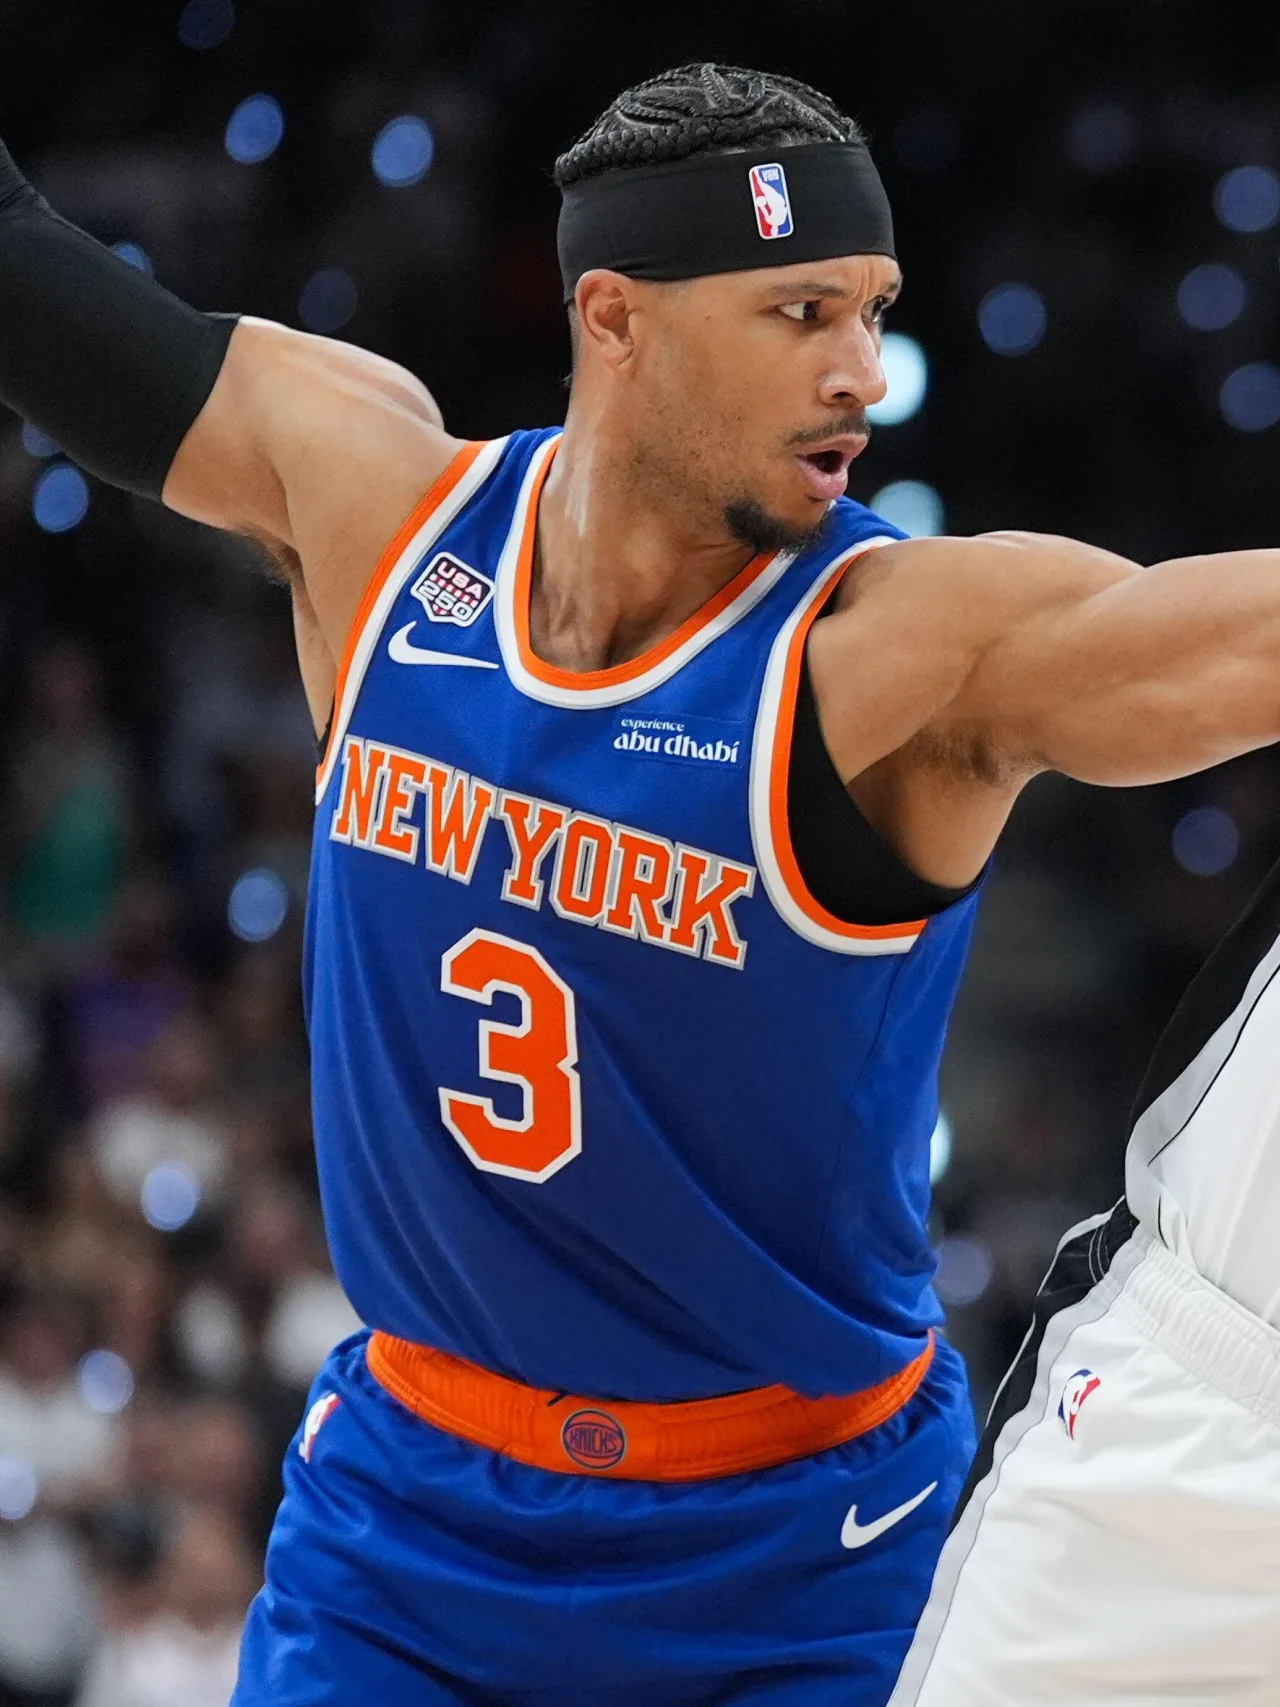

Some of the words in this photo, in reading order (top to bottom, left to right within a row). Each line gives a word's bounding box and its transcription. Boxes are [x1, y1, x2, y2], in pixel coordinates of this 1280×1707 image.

[416, 579, 474, 621] 250
[437, 561, 482, 600] USA
[621, 718, 685, 732] experience
[613, 730, 661, 753] abu
[664, 734, 740, 763] dhabi
[330, 736, 499, 885] NEW
[499, 791, 756, 970] YORK
[438, 927, 582, 1184] 3
